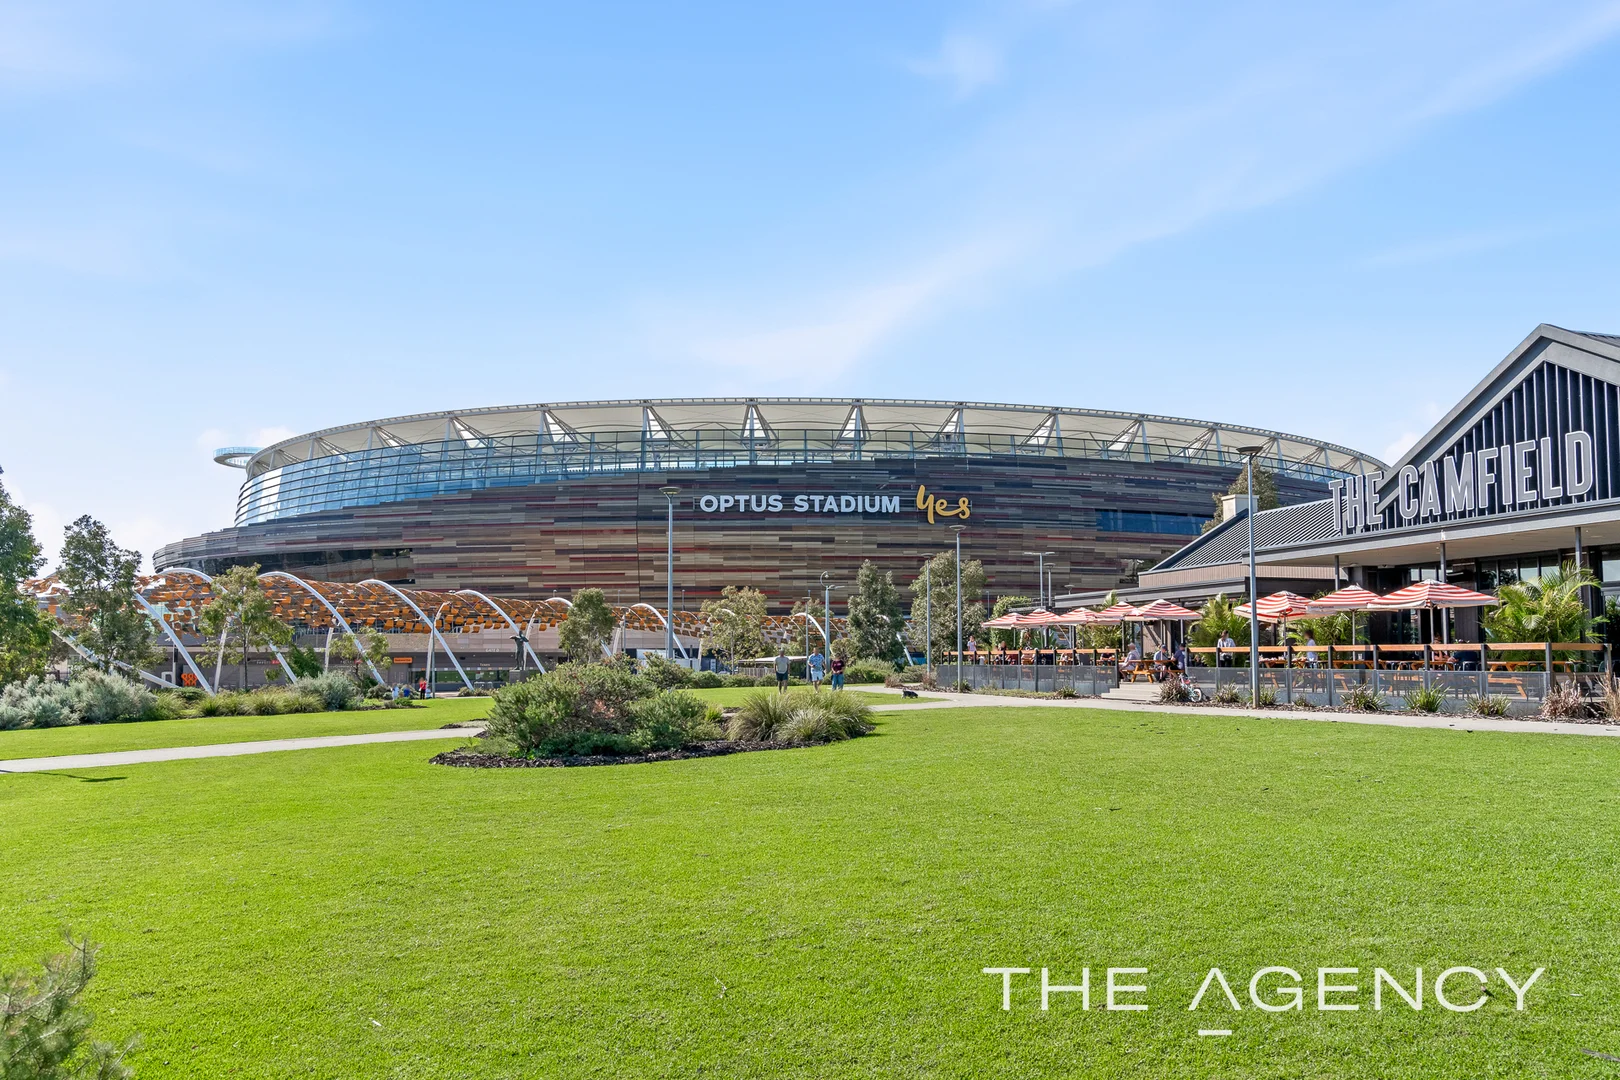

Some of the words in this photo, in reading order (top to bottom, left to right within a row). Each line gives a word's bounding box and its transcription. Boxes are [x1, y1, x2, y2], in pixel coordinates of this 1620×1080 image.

[699, 494, 783, 513] OPTUS
[793, 494, 900, 513] STADIUM
[1329, 470, 1383, 531] THE
[1398, 430, 1593, 520] CAMFIELD
